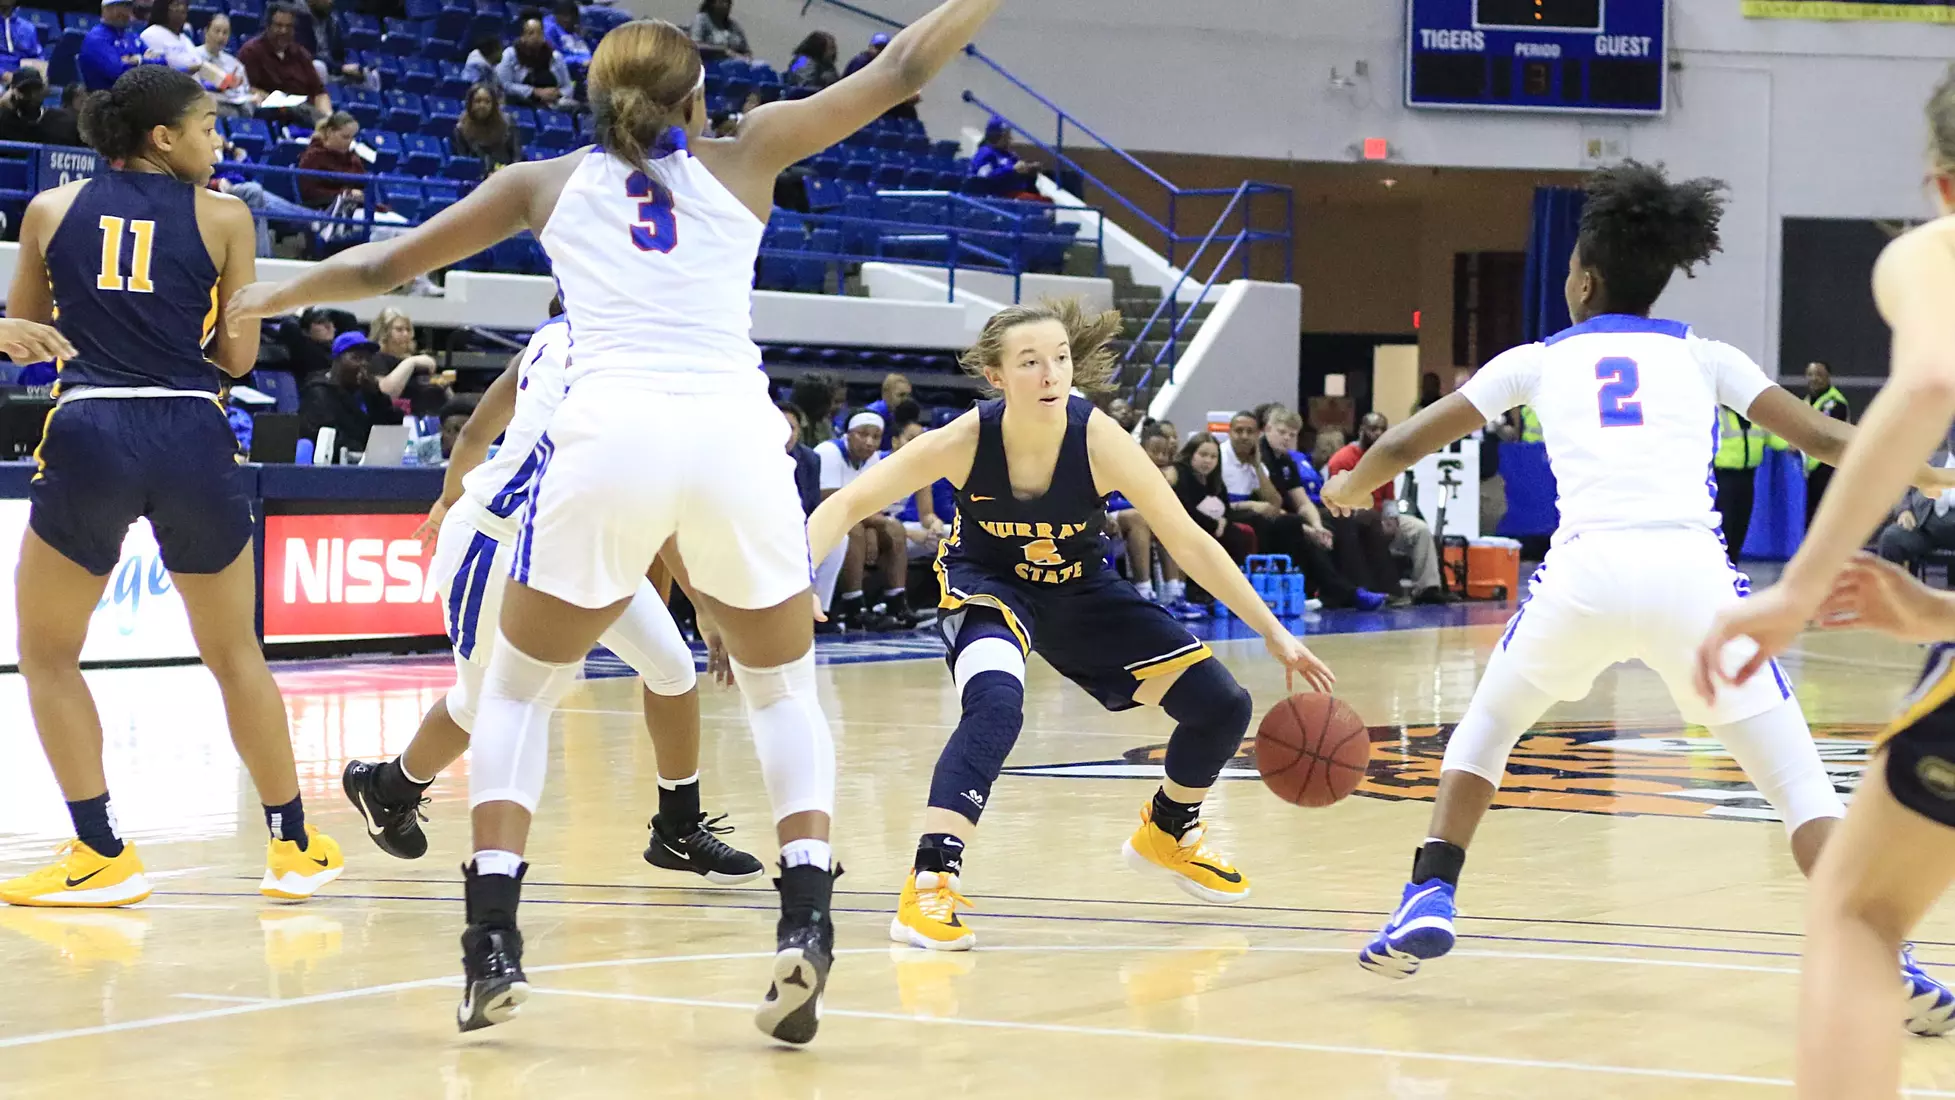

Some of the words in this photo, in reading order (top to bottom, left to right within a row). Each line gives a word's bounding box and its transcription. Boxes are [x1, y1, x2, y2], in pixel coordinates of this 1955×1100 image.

[1420, 29, 1485, 51] TIGERS
[1595, 35, 1652, 57] GUEST
[1514, 43, 1561, 58] PERIOD
[50, 151, 96, 173] SECTION
[625, 170, 678, 255] 3
[97, 214, 156, 293] 11
[1594, 356, 1644, 428] 2
[1014, 561, 1083, 584] STATE
